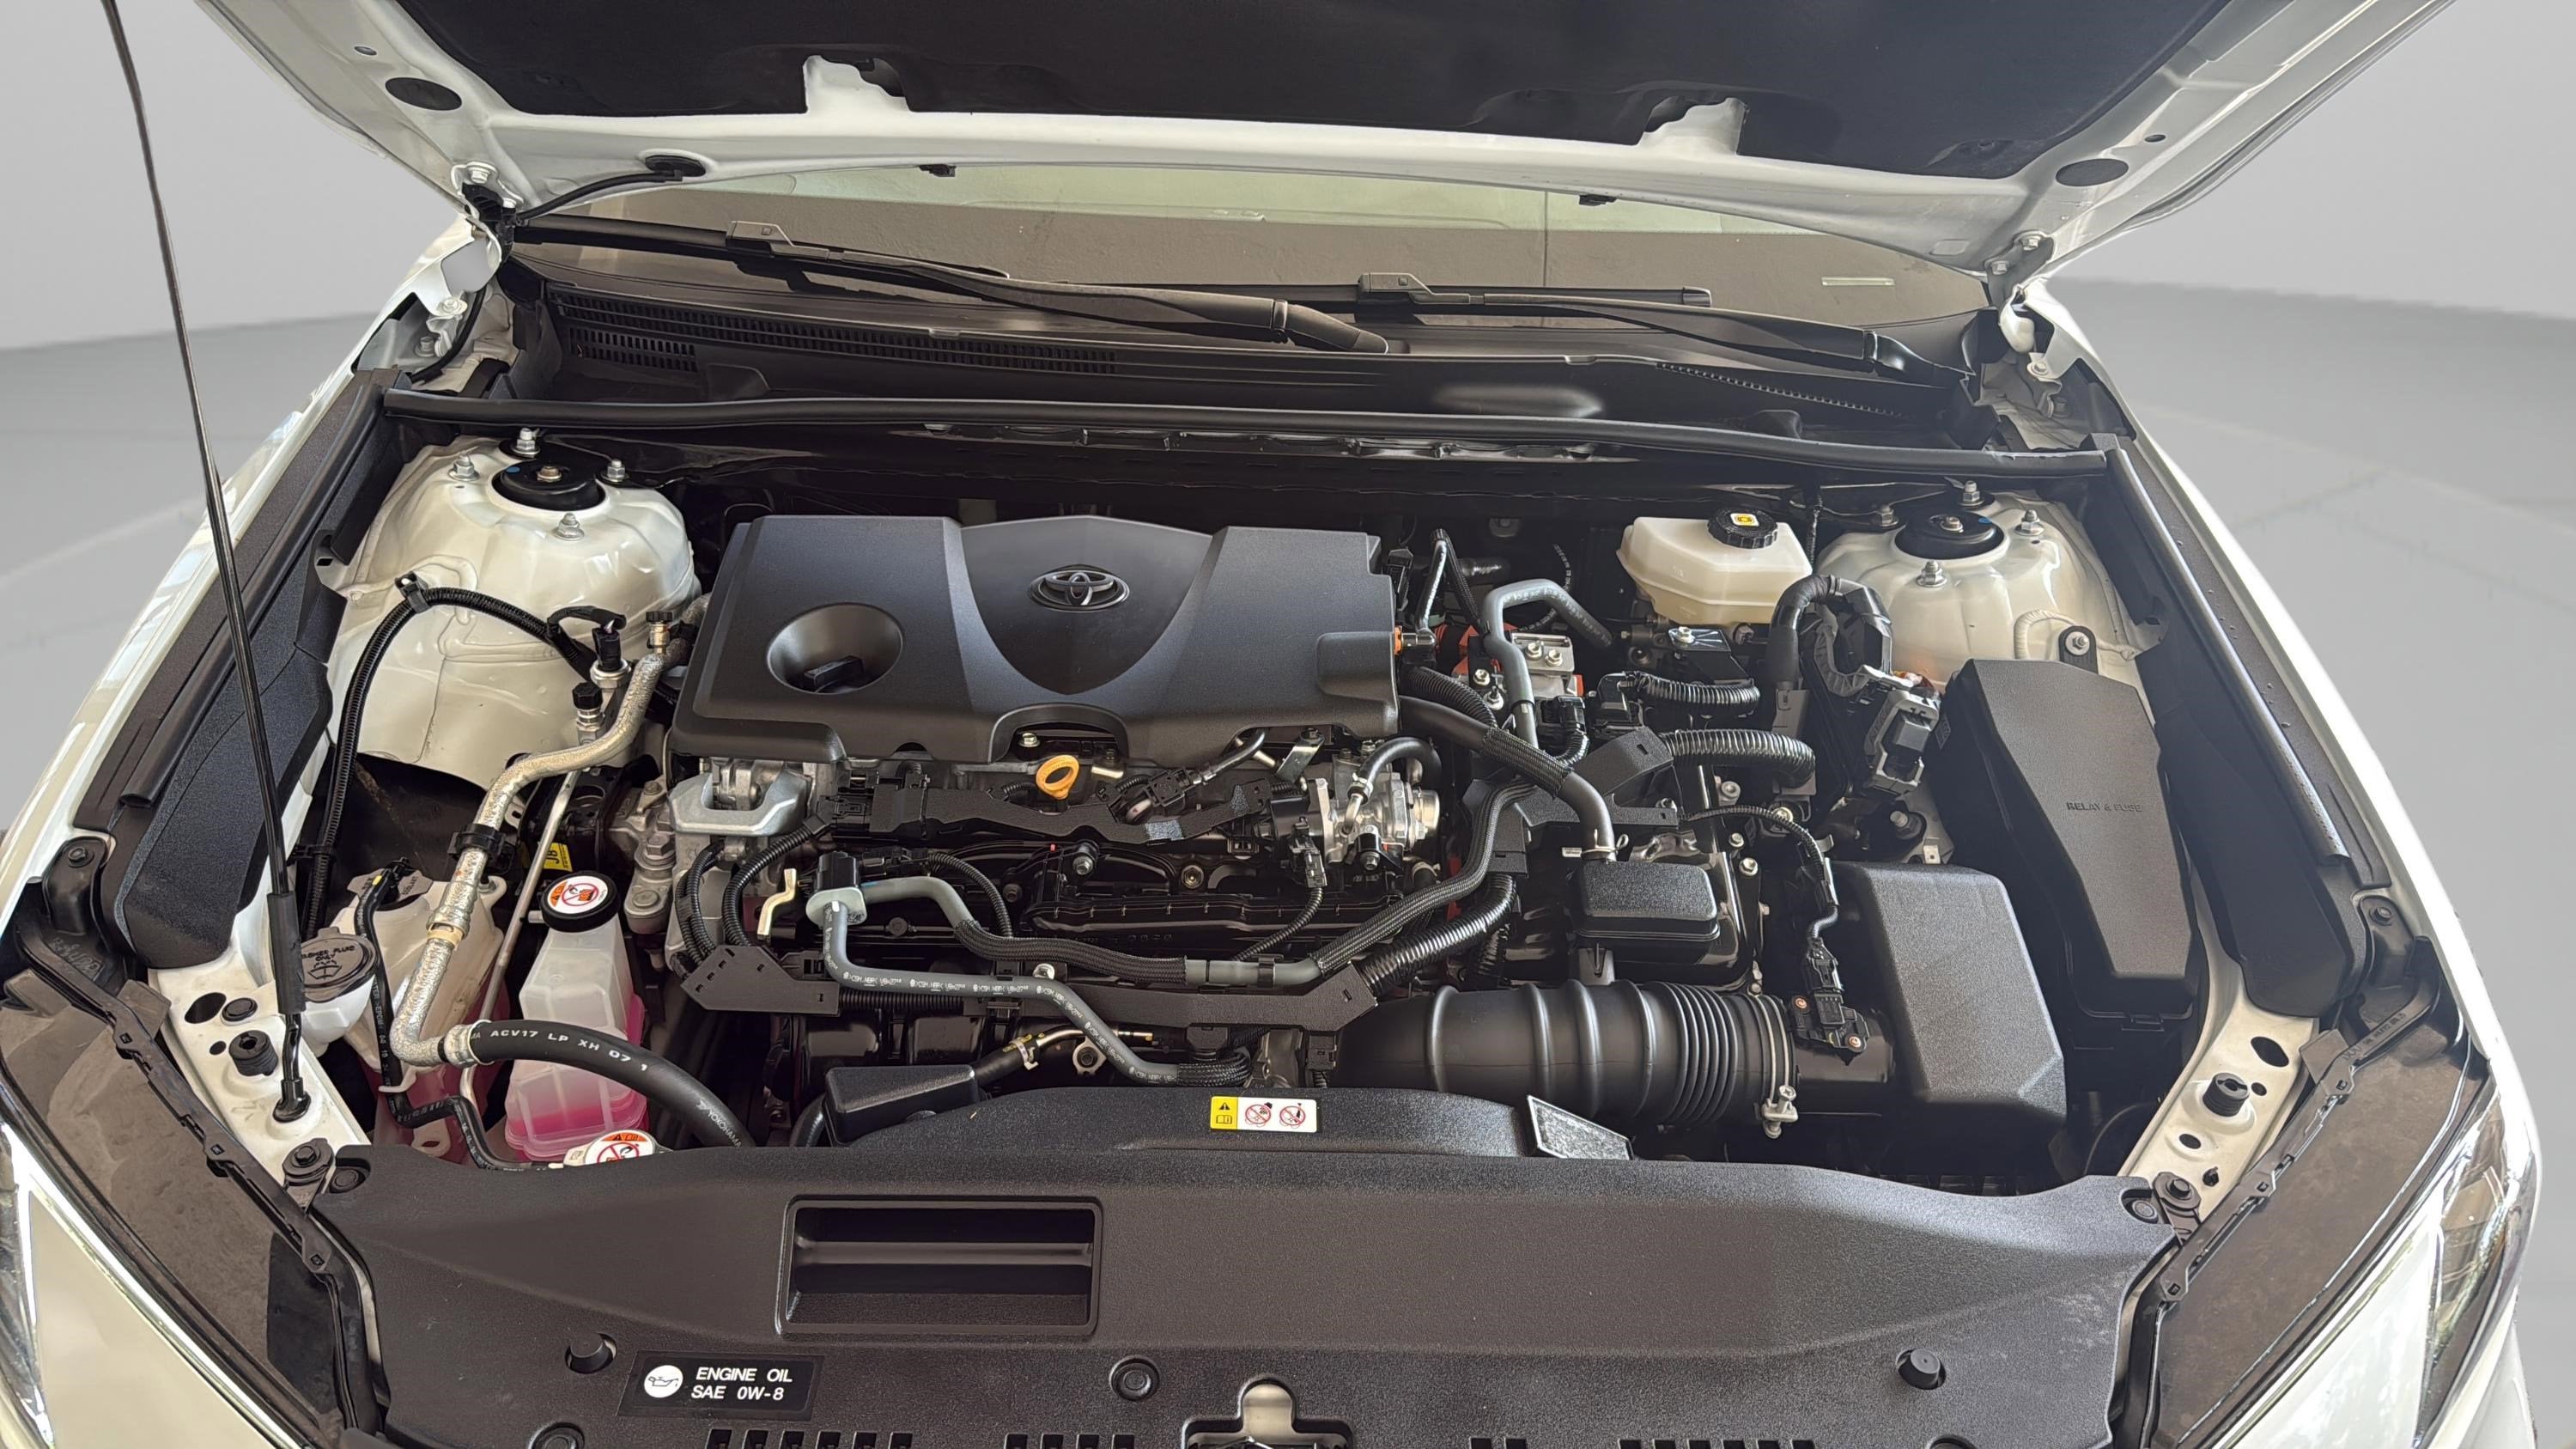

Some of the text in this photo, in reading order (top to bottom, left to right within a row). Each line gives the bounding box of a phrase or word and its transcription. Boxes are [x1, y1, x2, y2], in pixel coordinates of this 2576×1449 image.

[2066, 801, 2143, 813] RELAY & FUSE
[489, 1029, 539, 1038] ACV17
[547, 1032, 569, 1042] LP
[577, 1039, 600, 1051] XH
[608, 1050, 632, 1062] 07
[708, 1109, 742, 1148] YOKOHAMA
[696, 1367, 793, 1383] ENGINE OIL
[690, 1385, 785, 1401] SAE 0W-8
